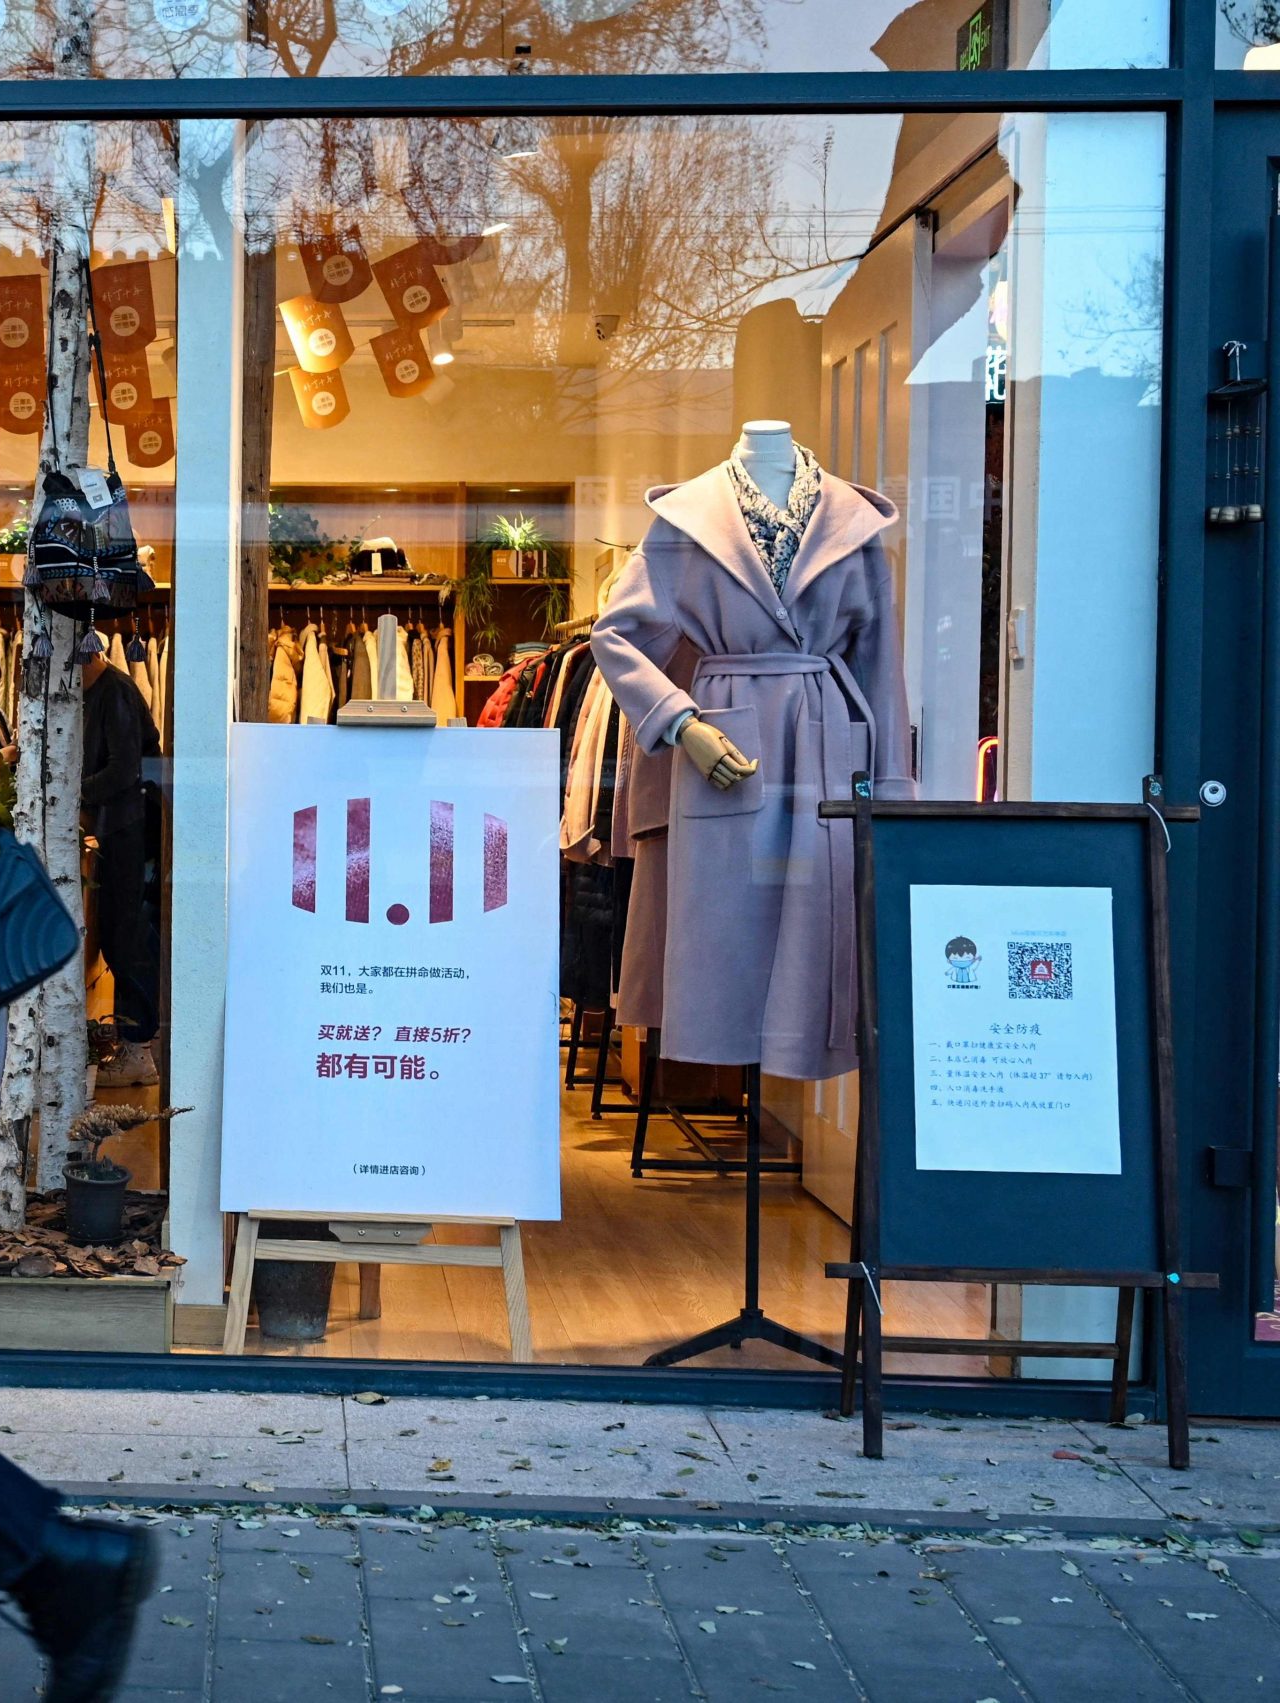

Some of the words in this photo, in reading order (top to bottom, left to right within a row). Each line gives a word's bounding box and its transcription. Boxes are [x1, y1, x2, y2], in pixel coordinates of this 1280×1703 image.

[989, 1022, 1043, 1036] 安全防疫
[316, 1052, 440, 1080] 都有可能。
